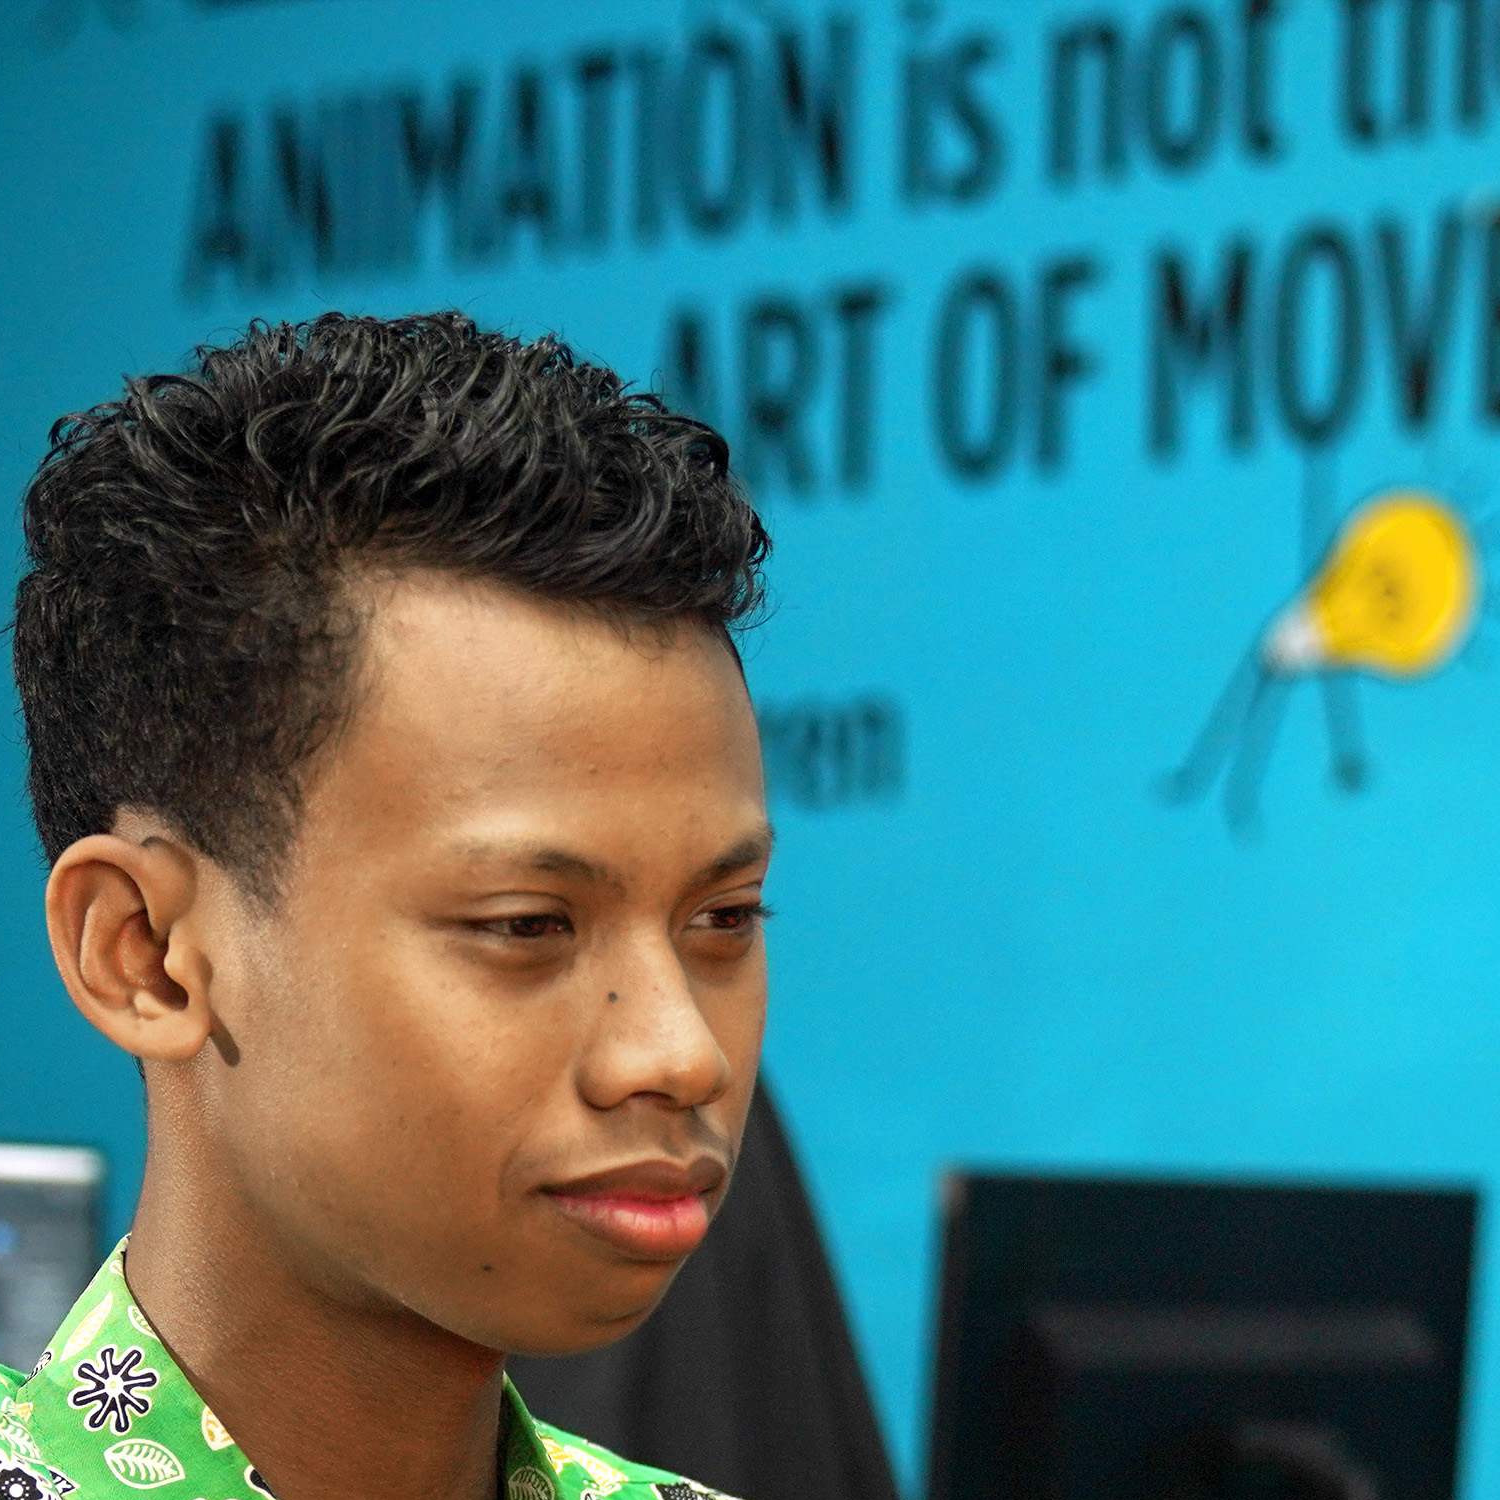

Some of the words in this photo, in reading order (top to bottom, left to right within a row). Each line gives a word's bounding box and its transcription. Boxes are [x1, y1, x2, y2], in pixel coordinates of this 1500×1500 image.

[188, 20, 860, 297] ANIMATION
[900, 24, 1007, 206] is
[1044, 0, 1288, 188] not
[930, 250, 1104, 485] OF
